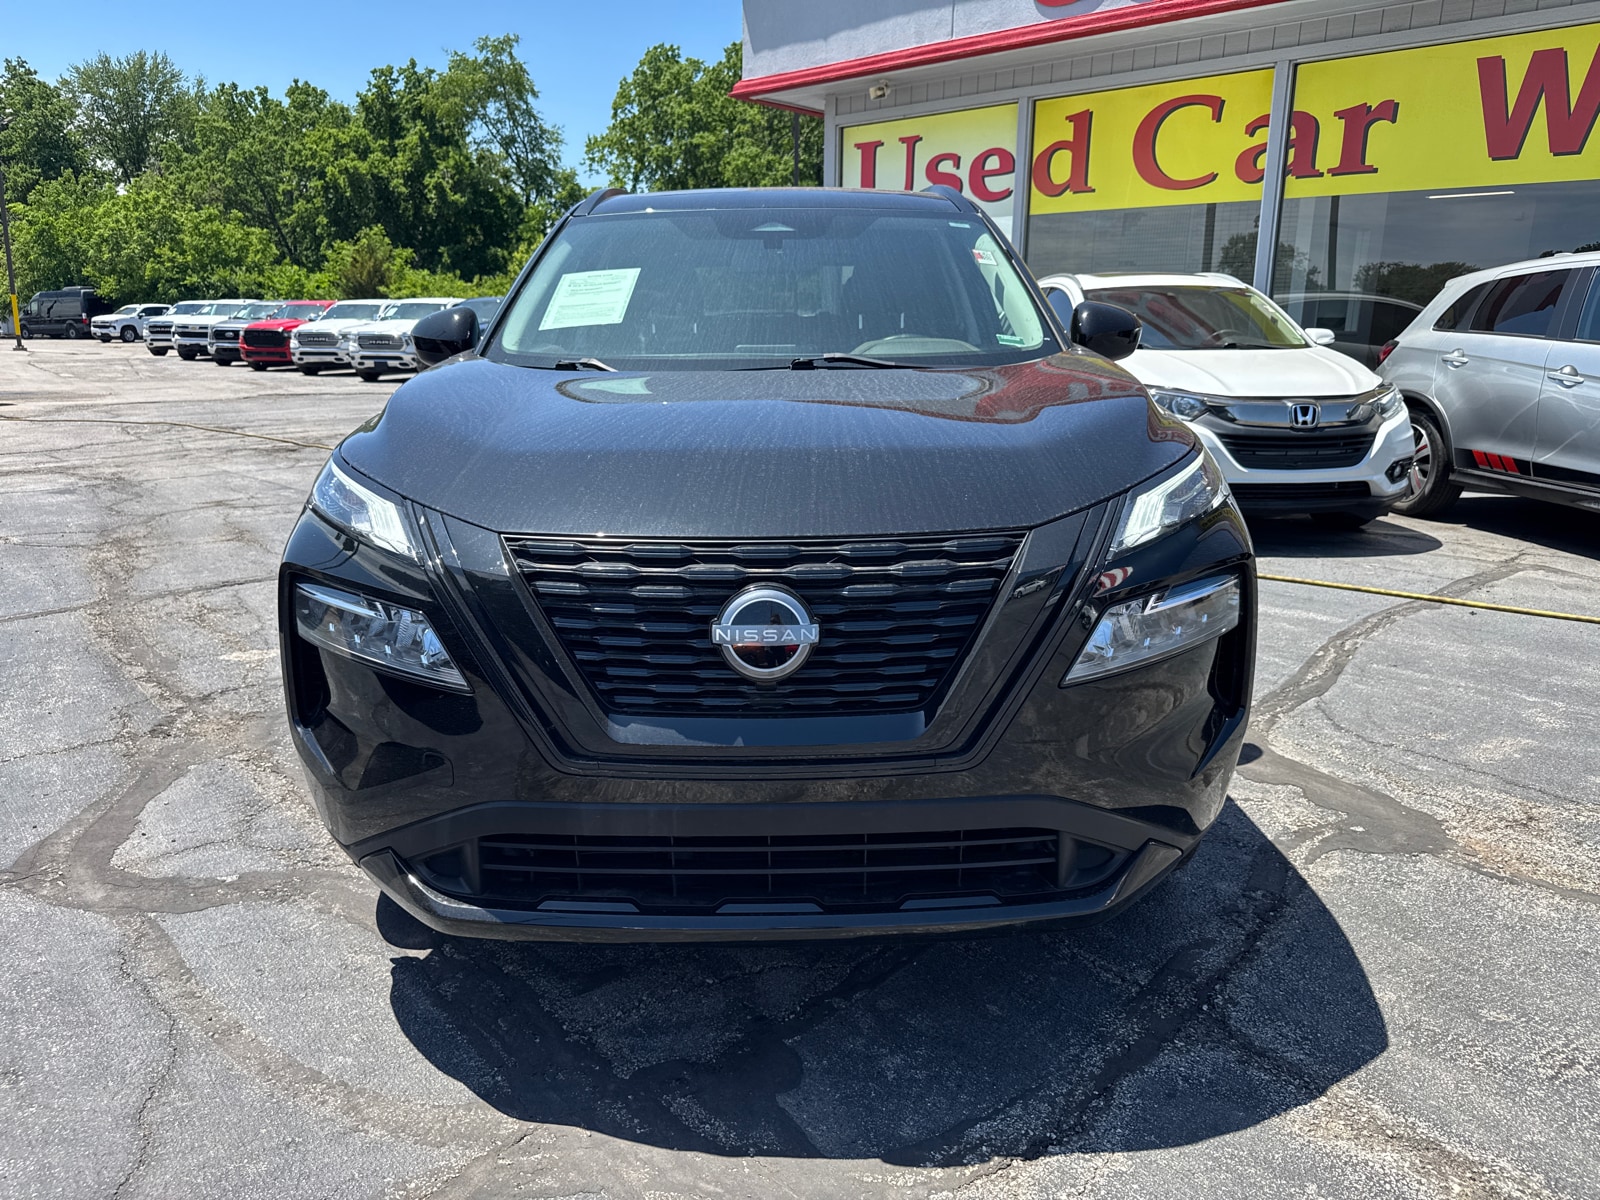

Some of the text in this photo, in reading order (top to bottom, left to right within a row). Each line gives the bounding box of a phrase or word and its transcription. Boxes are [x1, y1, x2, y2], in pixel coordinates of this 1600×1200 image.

[854, 109, 1096, 203] Used
[1132, 94, 1399, 190] Car
[715, 628, 817, 642] NISSAN
